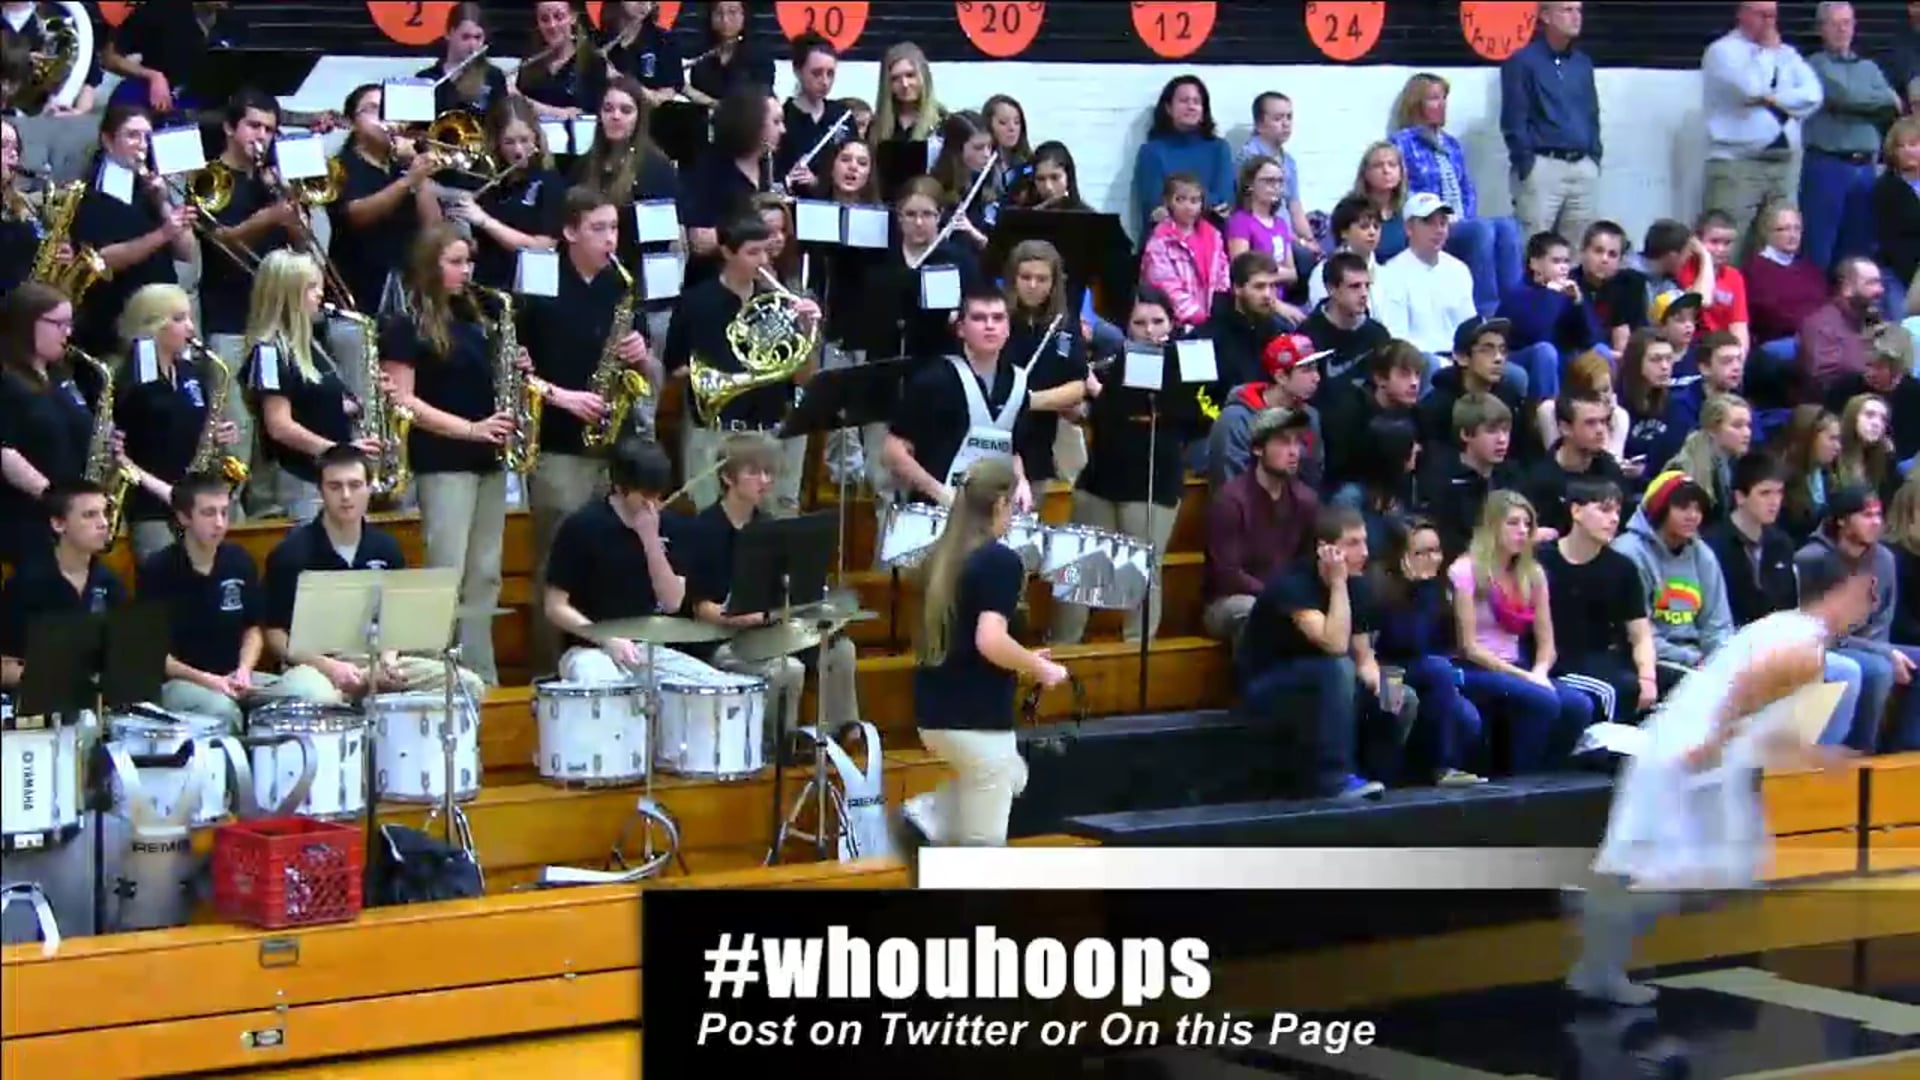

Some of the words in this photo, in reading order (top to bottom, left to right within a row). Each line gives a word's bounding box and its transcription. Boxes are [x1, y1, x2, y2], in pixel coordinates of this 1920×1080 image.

[804, 6, 844, 37] 20
[981, 3, 1021, 34] 20
[1155, 12, 1192, 41] 12
[1324, 13, 1363, 43] 24
[967, 437, 1010, 453] REMO
